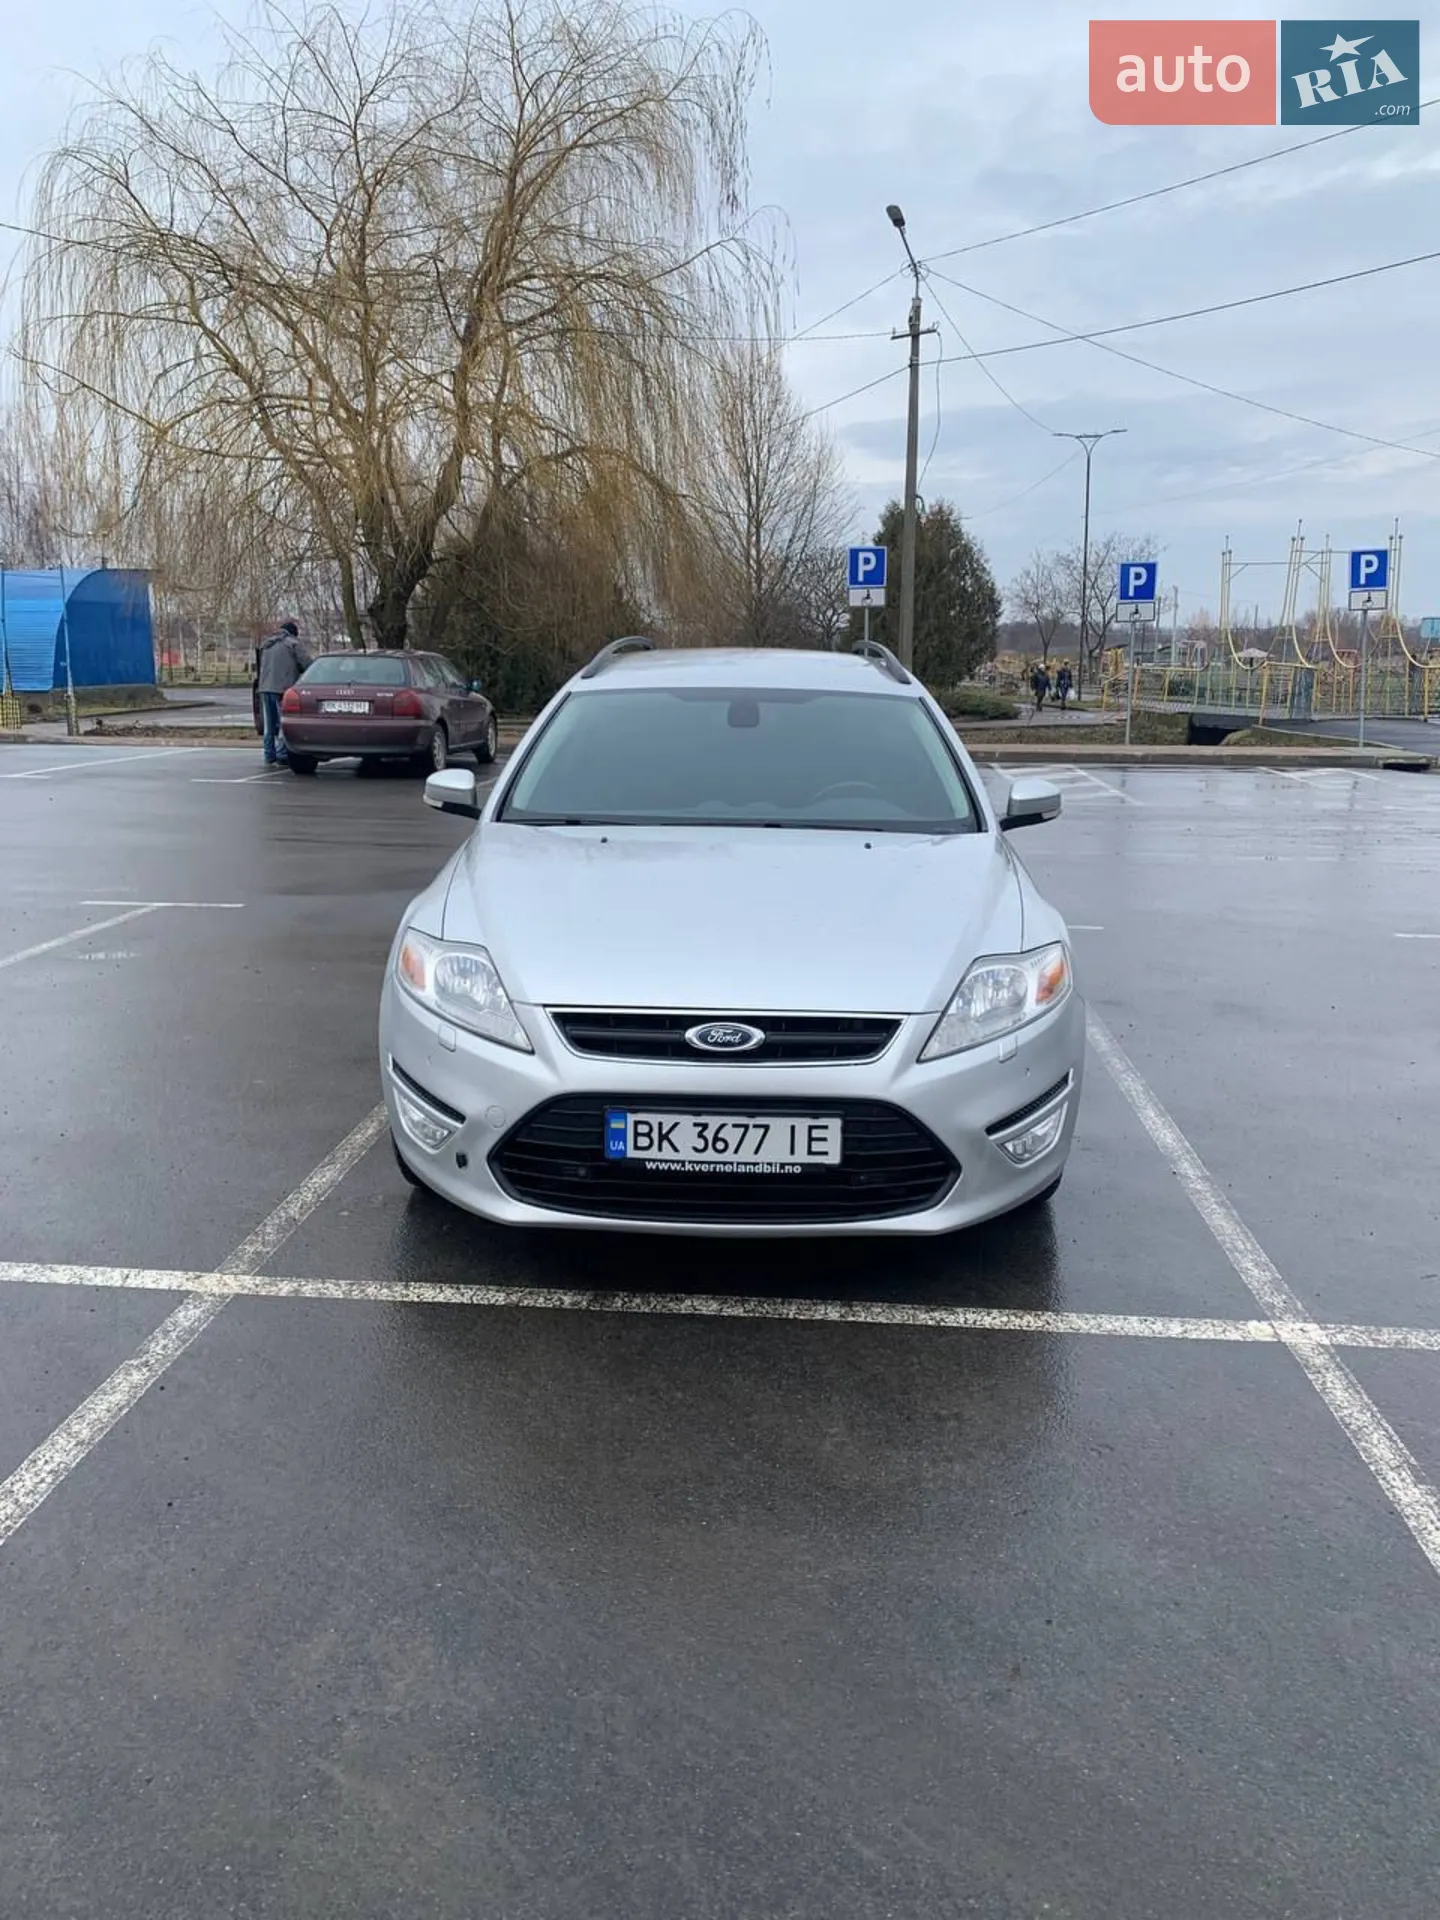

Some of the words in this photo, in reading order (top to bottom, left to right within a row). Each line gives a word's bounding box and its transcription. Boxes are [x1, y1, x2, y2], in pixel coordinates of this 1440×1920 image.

[858, 551, 877, 582] P
[1128, 566, 1147, 597] P
[1360, 554, 1379, 585] P
[707, 1028, 743, 1043] Ford
[610, 1139, 625, 1151] UA
[632, 1119, 680, 1153] BK
[691, 1121, 771, 1155] 3677
[789, 1123, 829, 1156] IE
[644, 1160, 802, 1174] www.kvernelandbil.no
